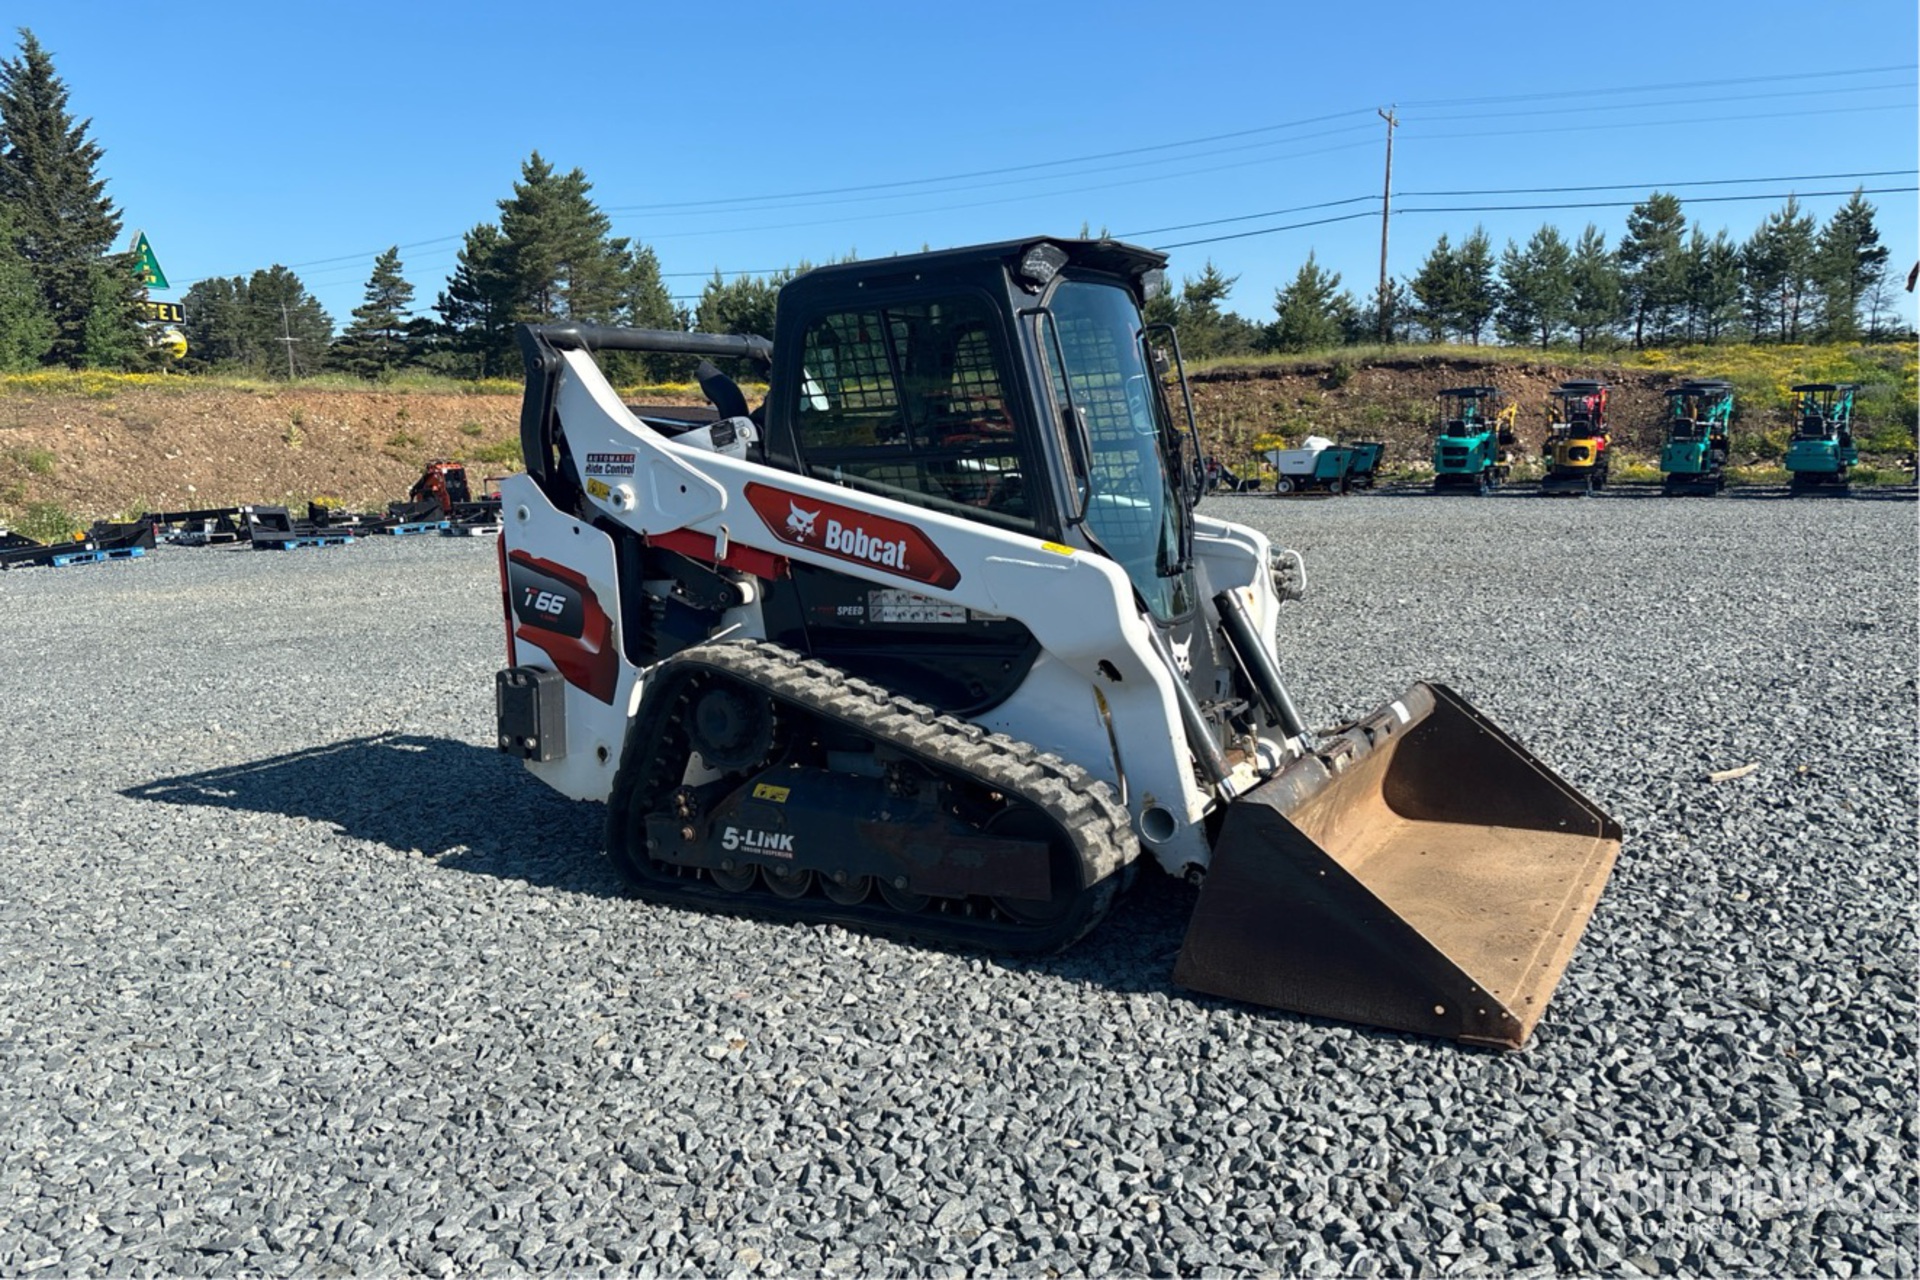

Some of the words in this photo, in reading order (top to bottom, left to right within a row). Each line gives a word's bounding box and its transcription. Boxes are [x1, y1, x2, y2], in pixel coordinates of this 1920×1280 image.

[605, 463, 635, 475] Control
[825, 519, 907, 570] Bobcat
[524, 587, 567, 615] T66
[837, 605, 865, 616] SPEED
[721, 826, 795, 851] 5-LINK
